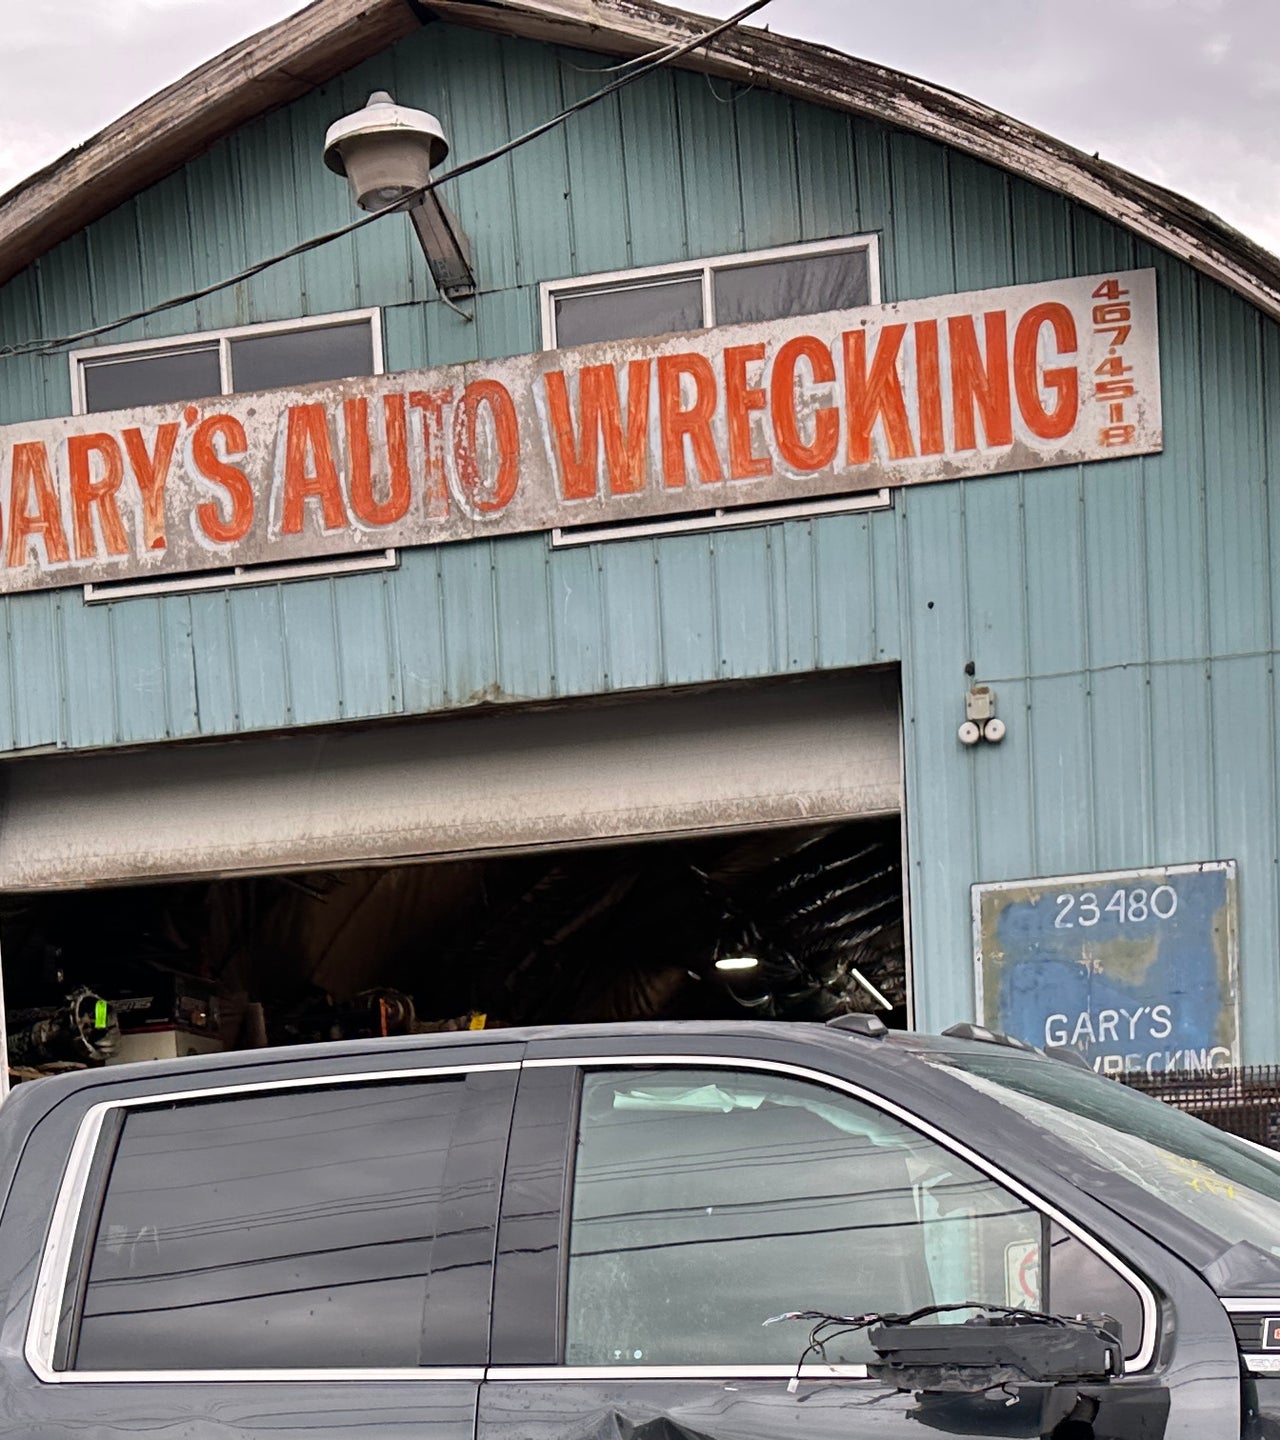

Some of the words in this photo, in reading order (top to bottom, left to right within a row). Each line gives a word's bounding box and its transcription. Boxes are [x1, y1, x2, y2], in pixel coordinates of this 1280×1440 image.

[278, 378, 519, 535] AUTO
[542, 301, 1078, 499] WRECKING
[1054, 885, 1178, 929] 23480
[1044, 1004, 1173, 1047] GARY'S
